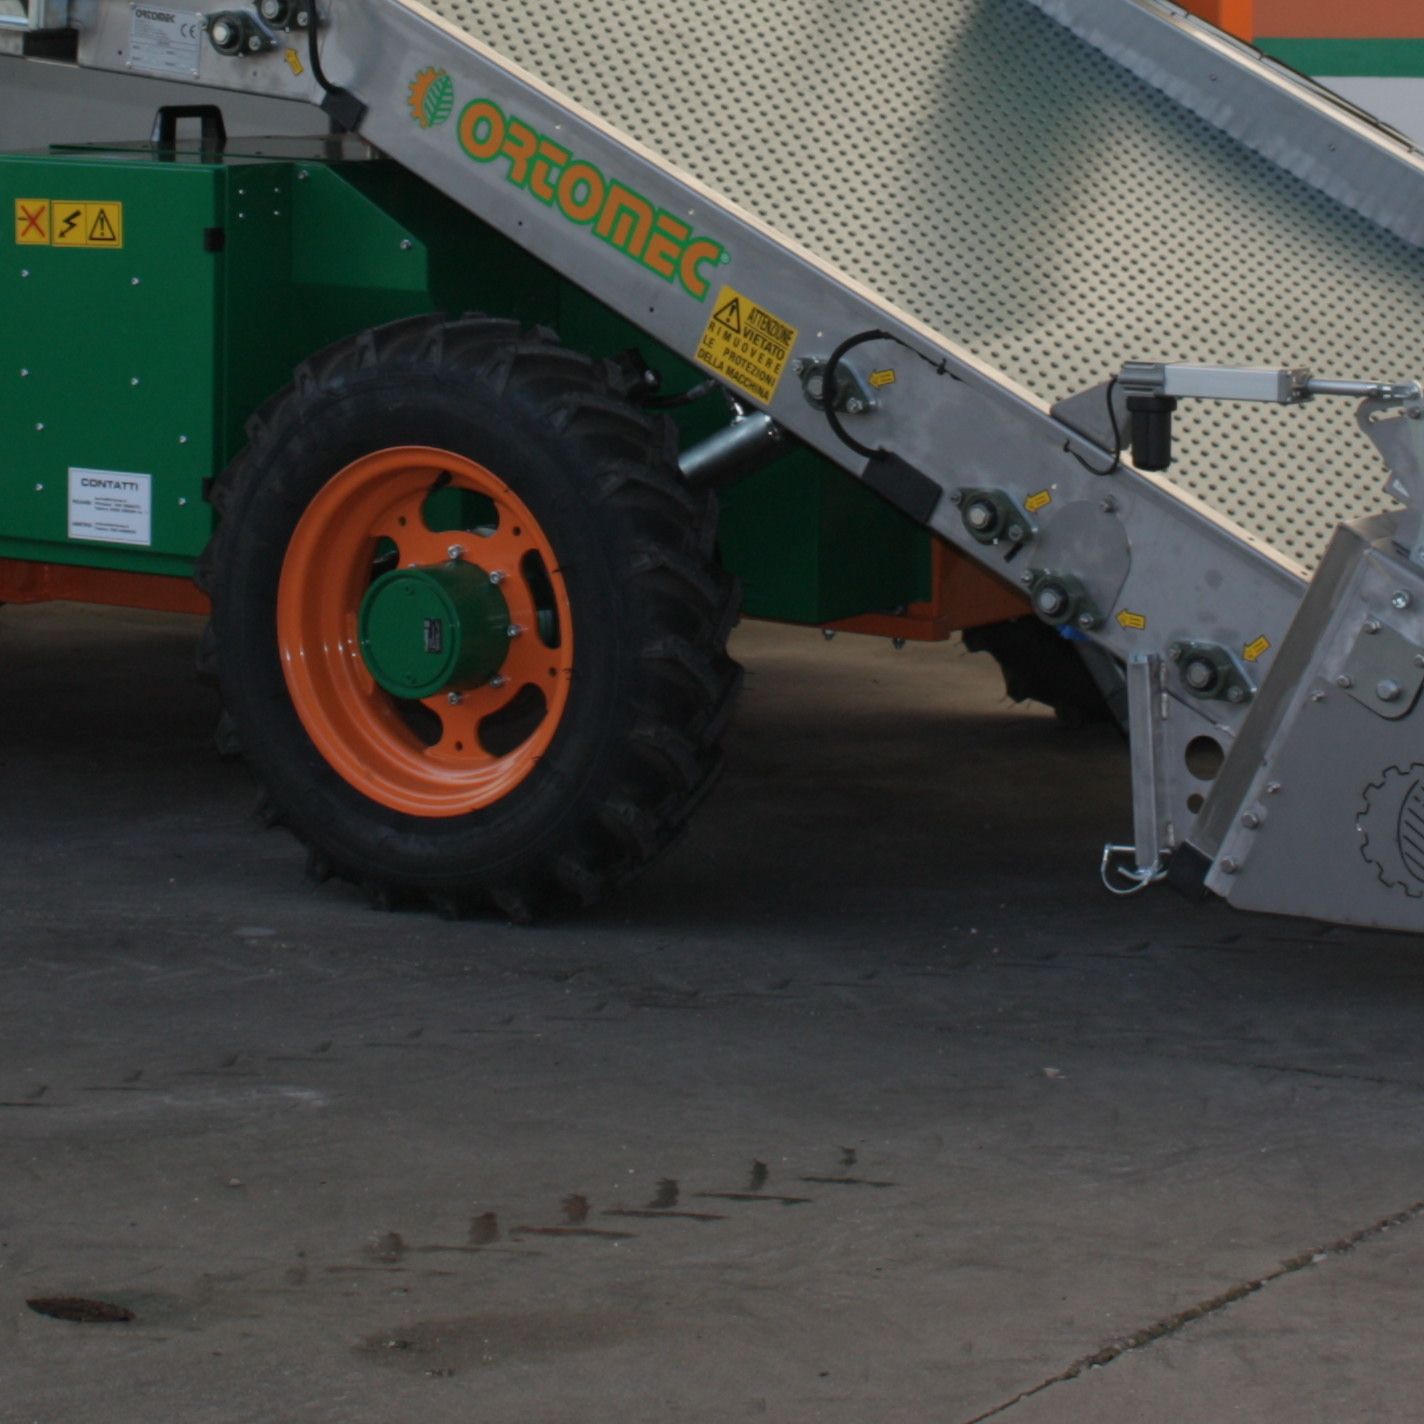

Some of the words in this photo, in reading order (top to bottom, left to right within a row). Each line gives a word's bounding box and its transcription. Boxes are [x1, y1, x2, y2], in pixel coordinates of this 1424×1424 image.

[456, 98, 725, 303] ORTOMEC
[743, 327, 785, 360] VIETATO
[747, 307, 794, 346] ATTENZIONE
[697, 348, 724, 371] DELLA
[726, 366, 770, 401] MACCHINA
[703, 334, 715, 348] LE
[723, 347, 776, 387] PROTEZIONI
[81, 478, 138, 491] CONTATTI
